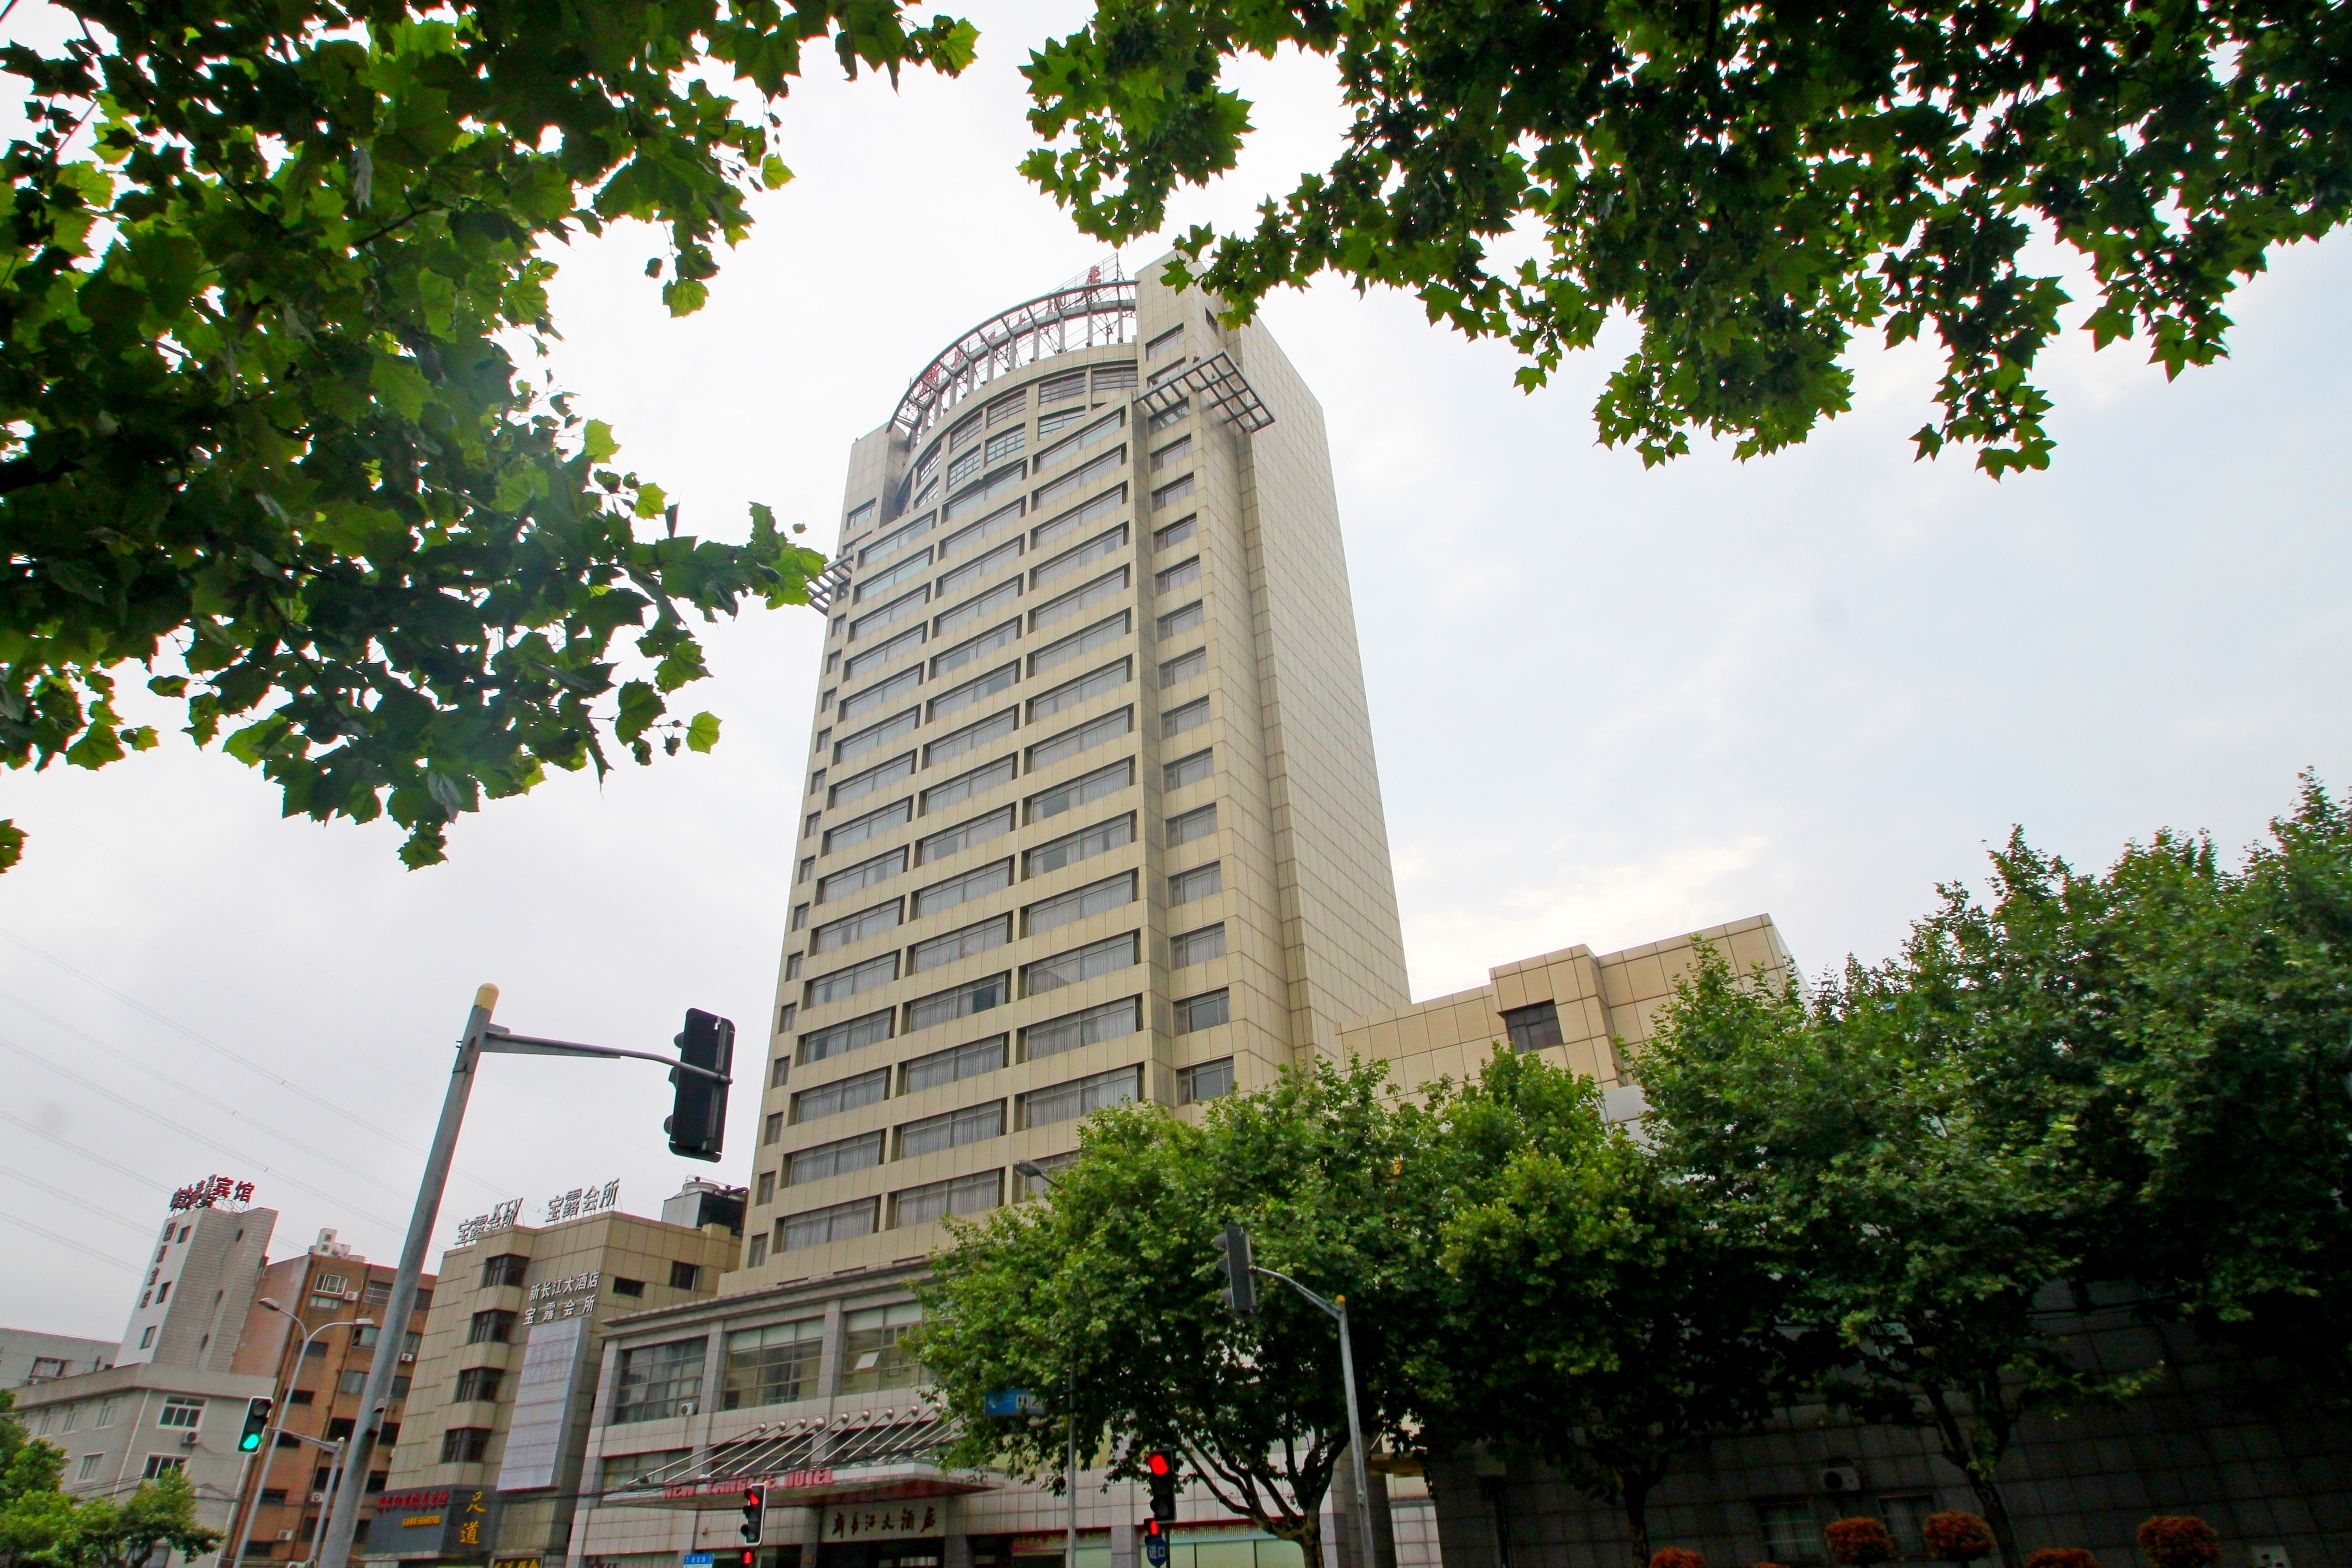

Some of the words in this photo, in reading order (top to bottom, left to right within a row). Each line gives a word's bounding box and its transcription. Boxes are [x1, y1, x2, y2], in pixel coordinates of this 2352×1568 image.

[494, 1197, 524, 1222] KTV
[545, 1178, 620, 1223] 宝露会所
[528, 1270, 601, 1302] 新长江大酒店
[522, 1294, 596, 1326] 宝露会所
[662, 1486, 696, 1499] NEW
[784, 1468, 833, 1489] HOTEL
